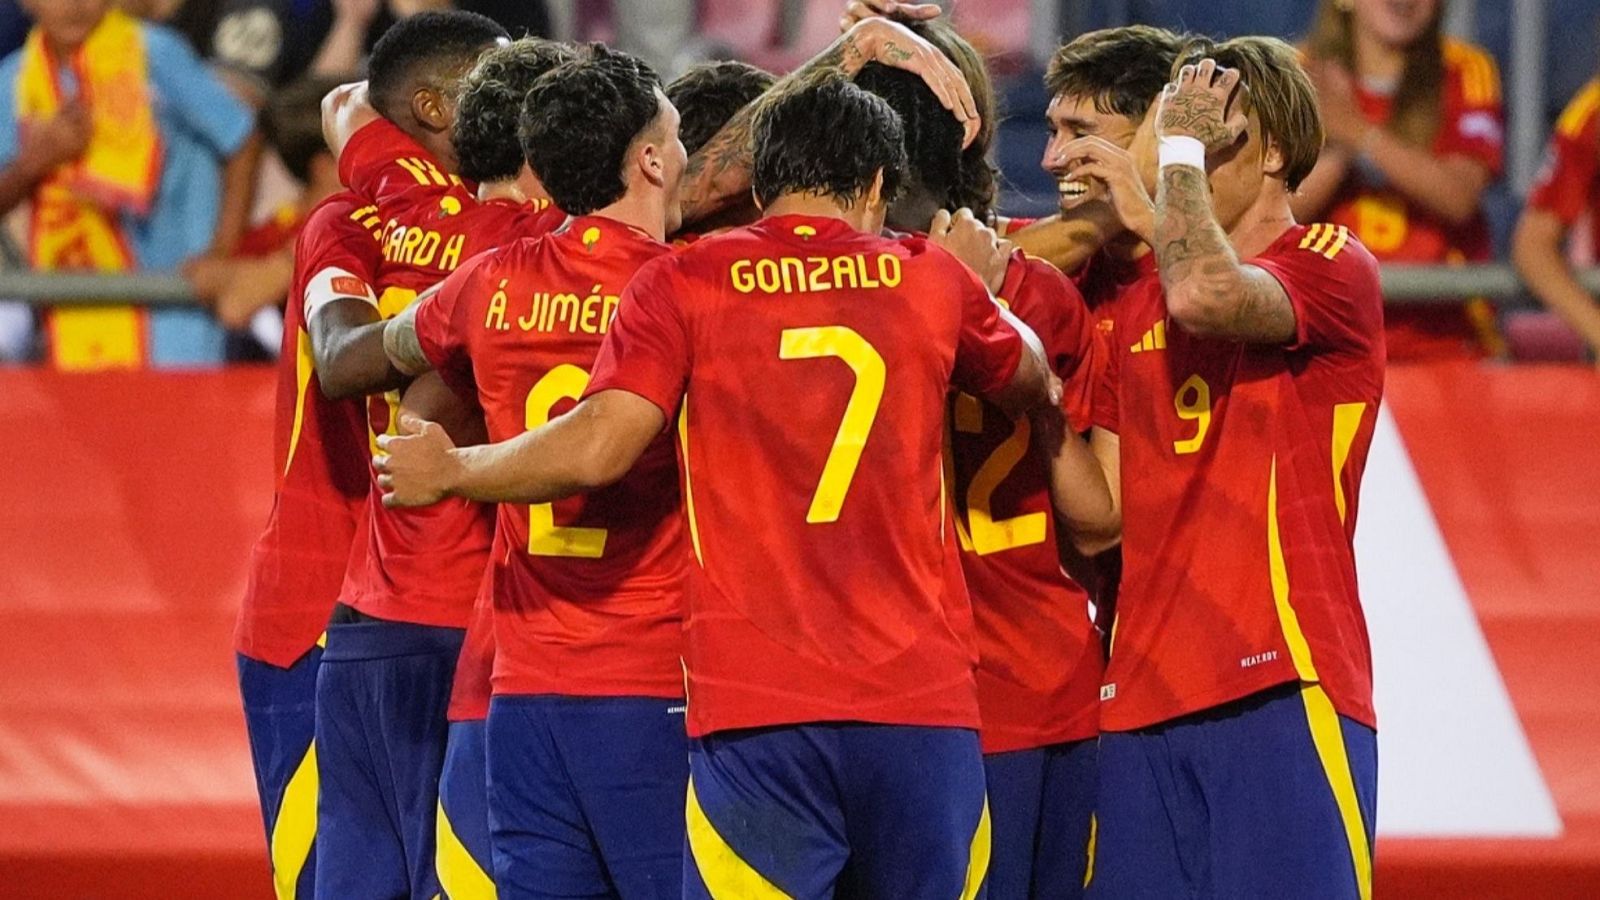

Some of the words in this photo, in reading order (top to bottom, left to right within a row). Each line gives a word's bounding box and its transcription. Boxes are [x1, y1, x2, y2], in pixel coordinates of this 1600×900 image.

[438, 234, 465, 270] H
[730, 253, 901, 293] GONZALO
[485, 278, 511, 331] Á.
[779, 325, 887, 523] 7
[1173, 373, 1211, 455] 9
[525, 363, 608, 558] 2
